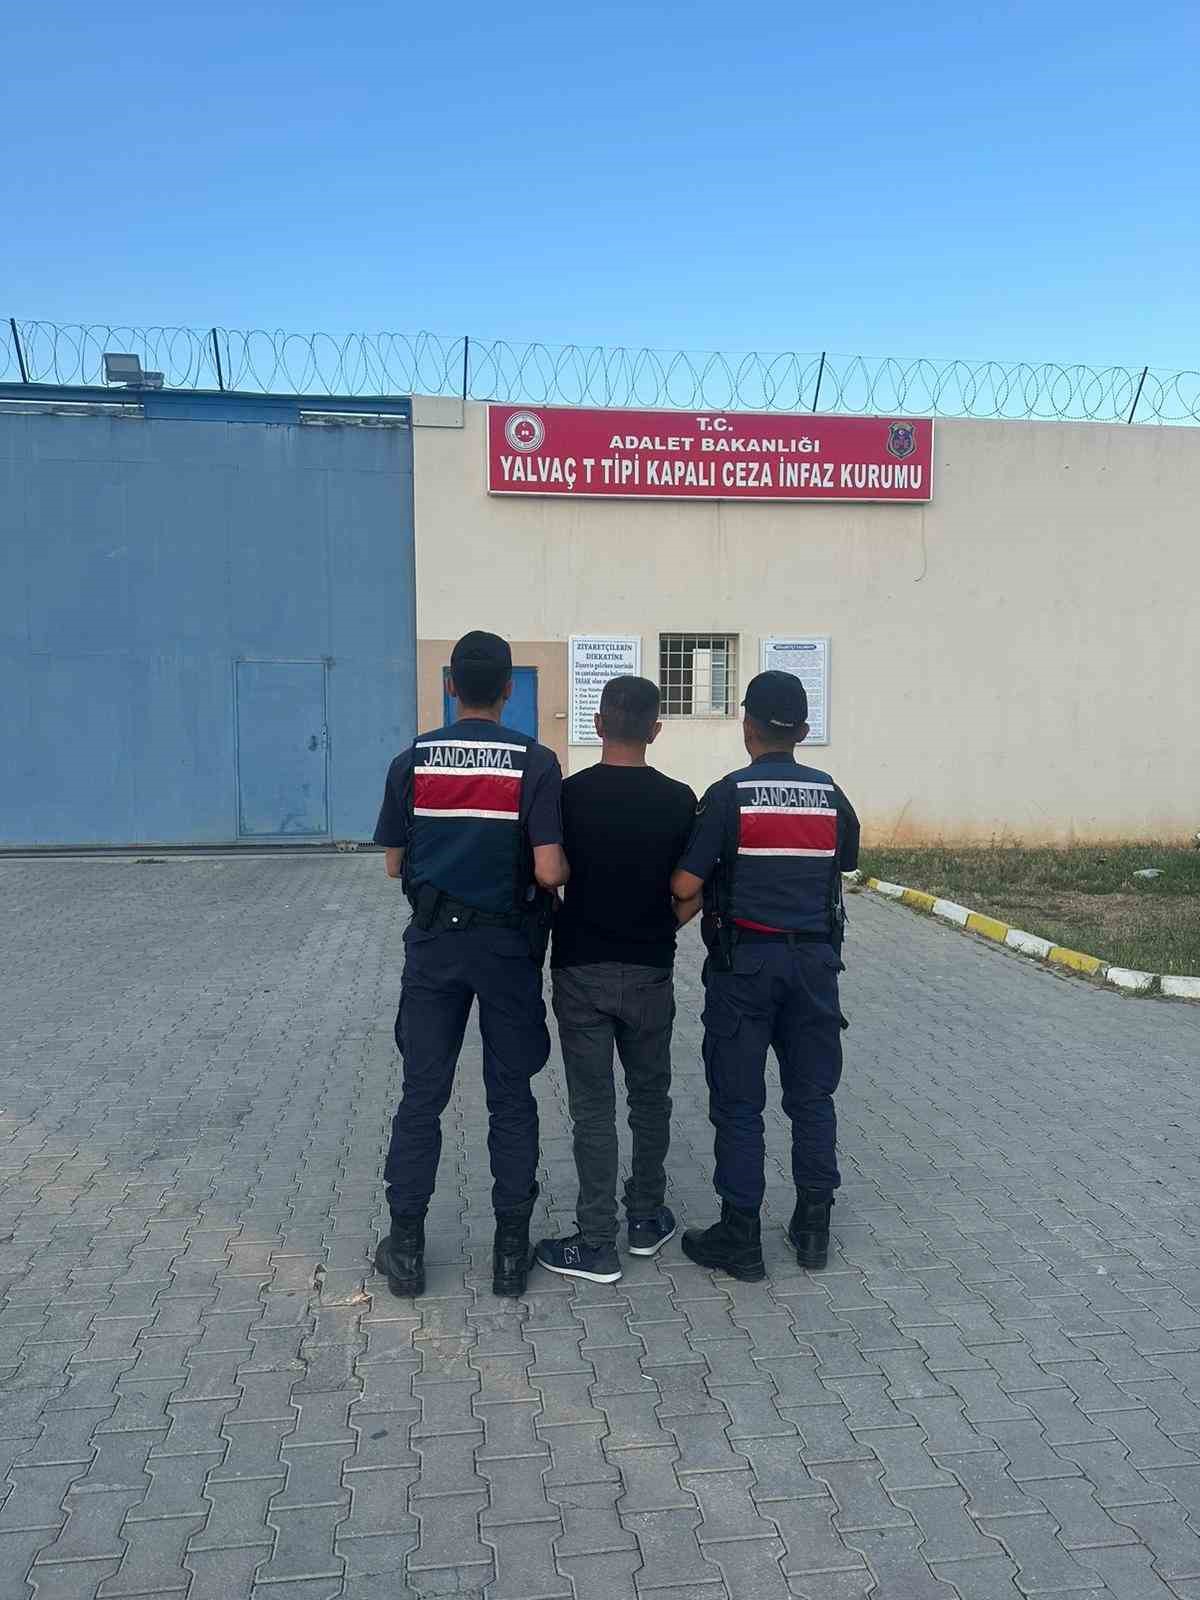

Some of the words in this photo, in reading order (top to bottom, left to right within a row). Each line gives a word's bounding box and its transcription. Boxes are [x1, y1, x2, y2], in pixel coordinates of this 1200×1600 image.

[696, 417, 733, 431] T.C.
[609, 436, 694, 450] ADALET
[702, 437, 820, 453] BAKANLIĞI
[500, 455, 576, 489] YALVAÇ
[583, 458, 595, 483] T
[601, 453, 640, 485] TİPİ
[647, 460, 716, 486] KAPALI
[722, 462, 773, 487] CEZA
[779, 456, 834, 488] İNFAZ
[840, 463, 922, 489] KURUMU
[424, 747, 513, 768] JANDARMA
[751, 787, 830, 808] JANDARMA
